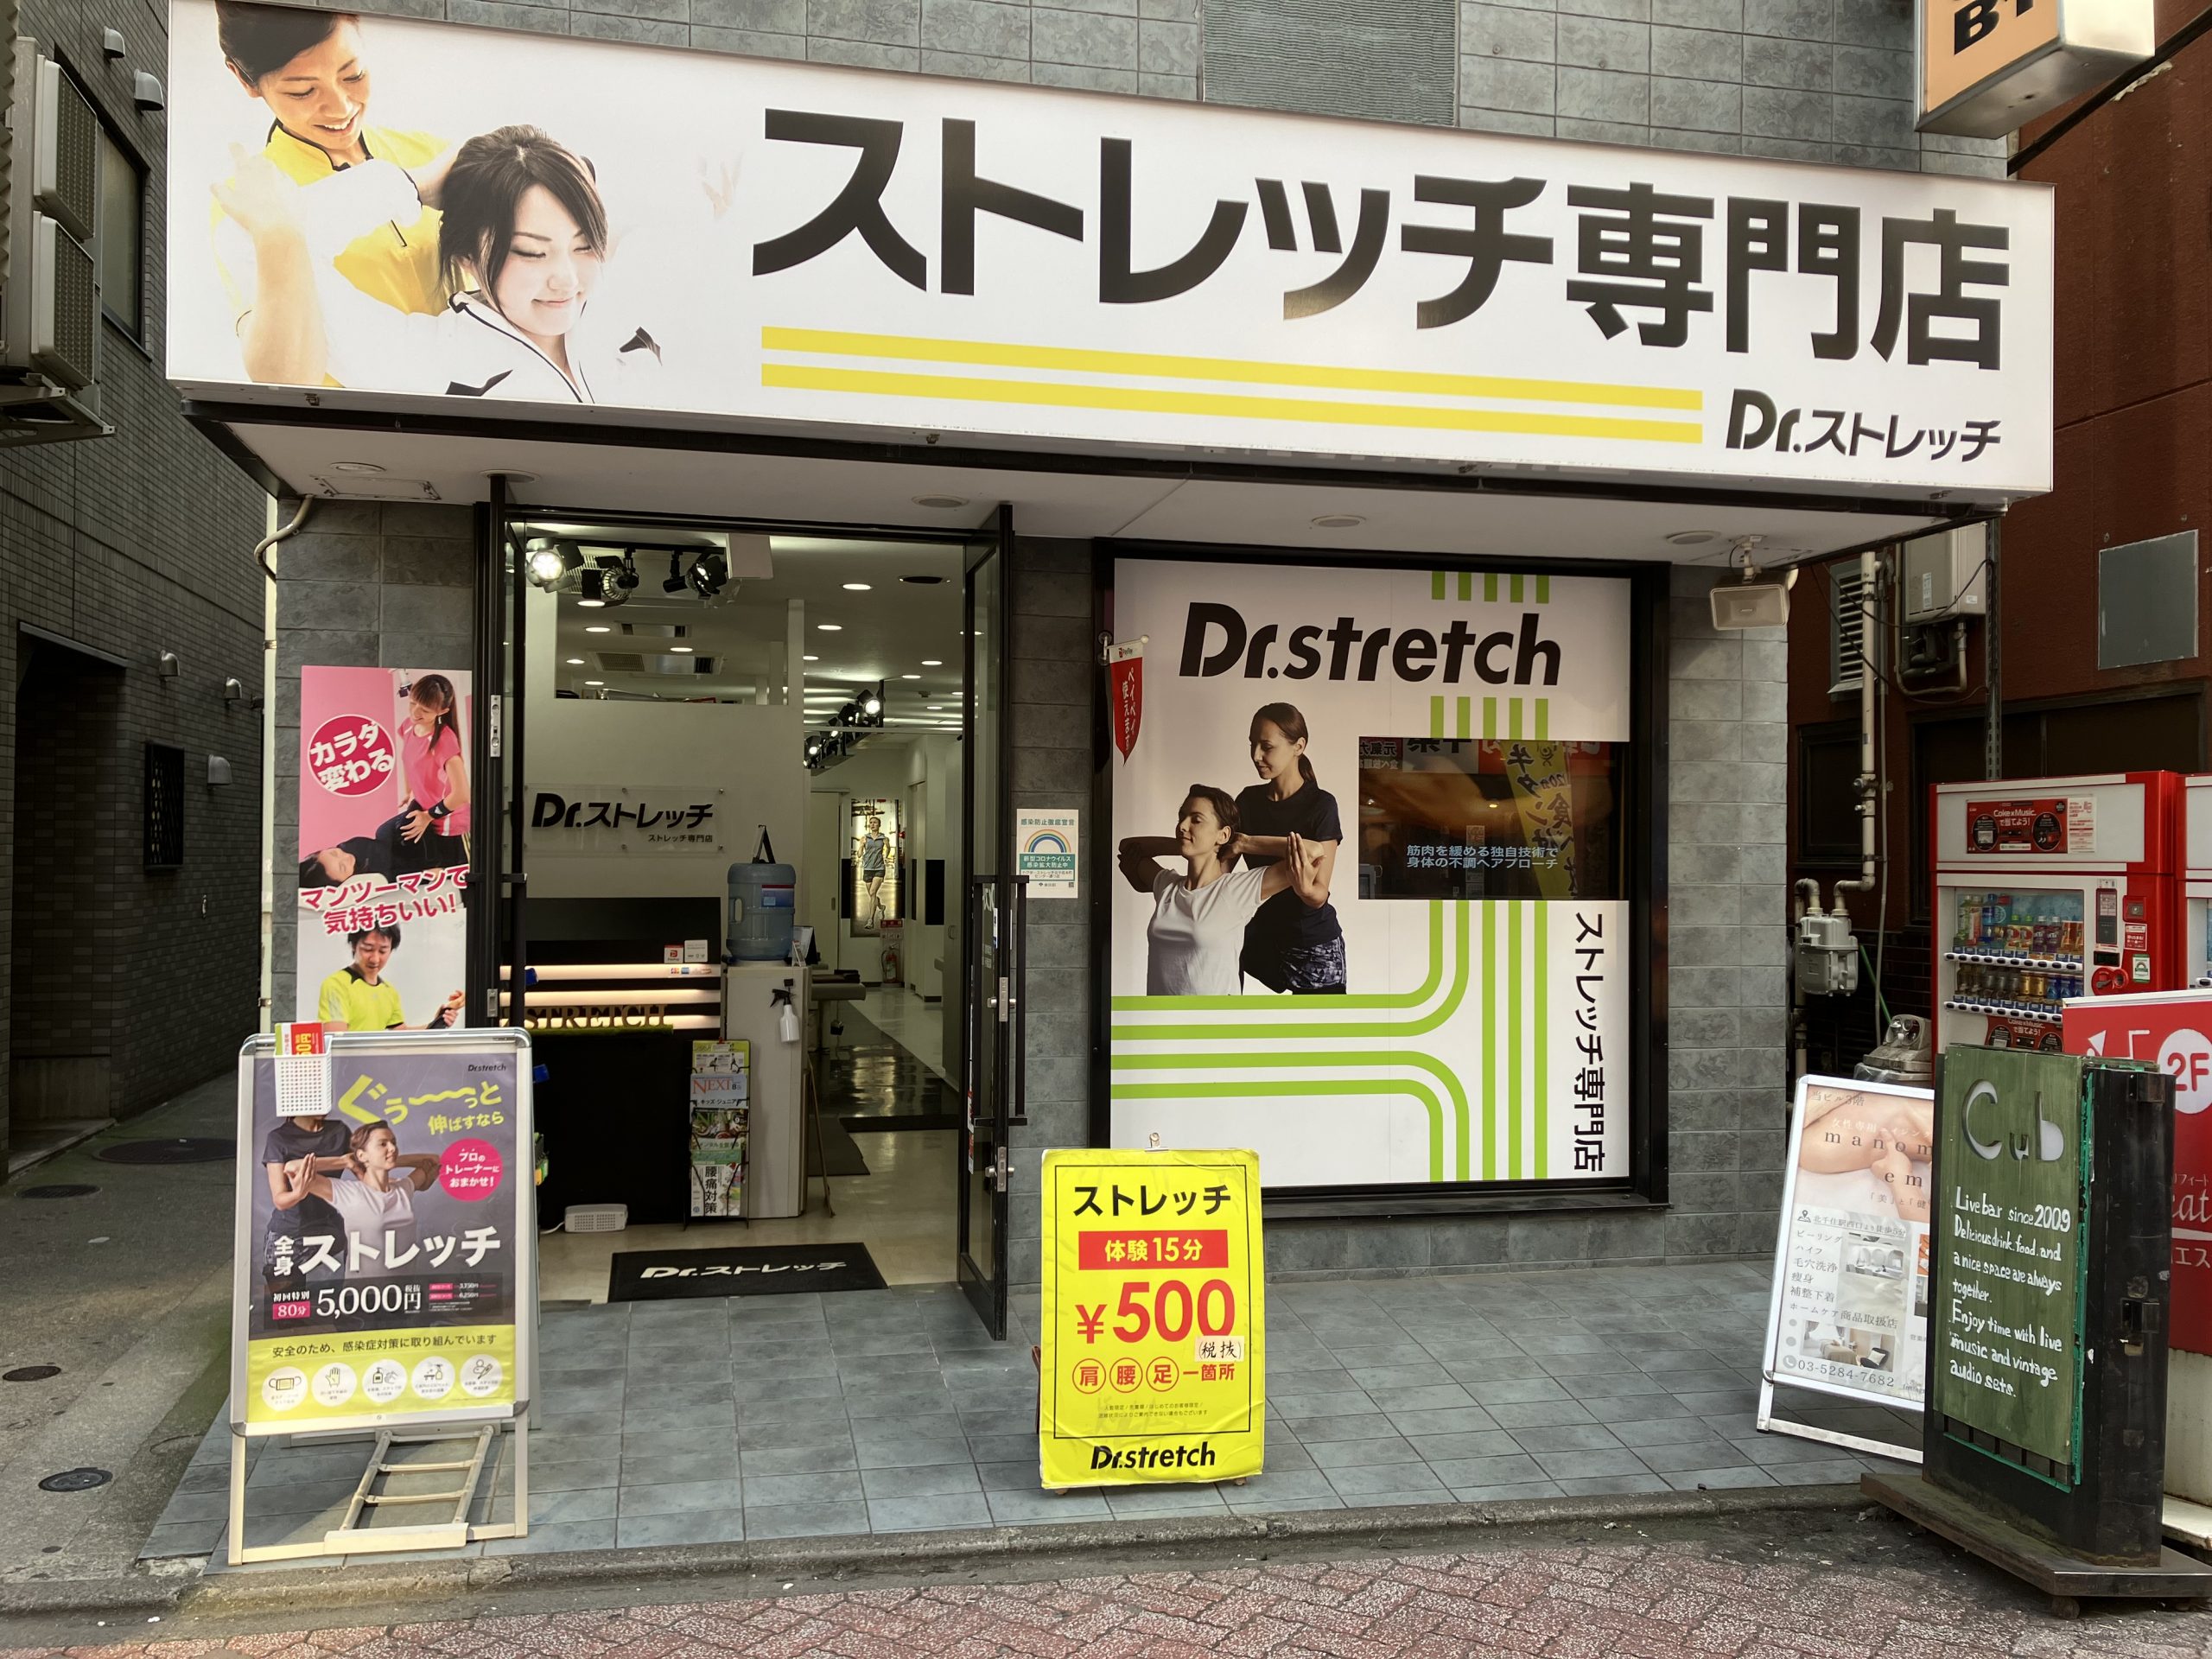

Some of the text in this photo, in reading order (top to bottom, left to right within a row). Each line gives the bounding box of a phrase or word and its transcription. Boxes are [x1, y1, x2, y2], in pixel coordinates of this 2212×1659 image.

[752, 108, 2010, 370] ストレッチ専門店
[1726, 389, 2001, 462] Dr.ストレッチ
[1179, 601, 1562, 686] Dr.stretch
[310, 721, 379, 766] カラダ
[317, 748, 394, 791] 変わる
[531, 792, 713, 829] Dr.ストレッチ
[648, 834, 713, 842] ストレッチ専門店
[1407, 845, 1558, 858] 筋肉を緩める独自技術で
[301, 865, 469, 909] マンツーマンで
[323, 893, 456, 934] 気持ちいい!
[524, 1004, 668, 1029] STRETCH
[1574, 912, 1605, 1172] ストレッチ専門店
[2167, 1052, 2210, 1092] 2F
[1810, 1091, 1865, 1107] 当ビル3階
[429, 1110, 504, 1135] 伸ばすなら
[1961, 1079, 2064, 1161] Cub
[446, 1164, 499, 1174] トレーナーに
[459, 1149, 486, 1162] プロの
[705, 1166, 717, 1214] 腰痛対策
[1073, 1185, 1230, 1217] ストレッチ
[1955, 1185, 2071, 1232] Live bar since 2009
[273, 1225, 501, 1276] 全身 ストレッチ
[1105, 1237, 1203, 1262] 体験15分
[2041, 1243, 2062, 1262] and
[639, 1262, 847, 1279] Dr.ストレッチ
[1793, 1257, 1838, 1272] 毛穴洗浄
[1954, 1251, 2062, 1296] a nice space are always
[273, 1290, 310, 1302] 初回特別
[1789, 1286, 1835, 1303] 補整下着
[277, 1304, 307, 1318] 80分
[1952, 1299, 2063, 1352] Enjoy time with live
[272, 1334, 497, 1358] 安全のため、感染症対策に取り組んでいます
[1950, 1333, 1987, 1359] music
[1991, 1348, 2012, 1367] and
[1079, 1363, 1236, 1386] 肩 腰 足 一箇所
[1797, 1359, 1895, 1388] 03-5284-7682
[1949, 1360, 1982, 1384] audio
[1090, 1441, 1216, 1470] Dr.stretch
